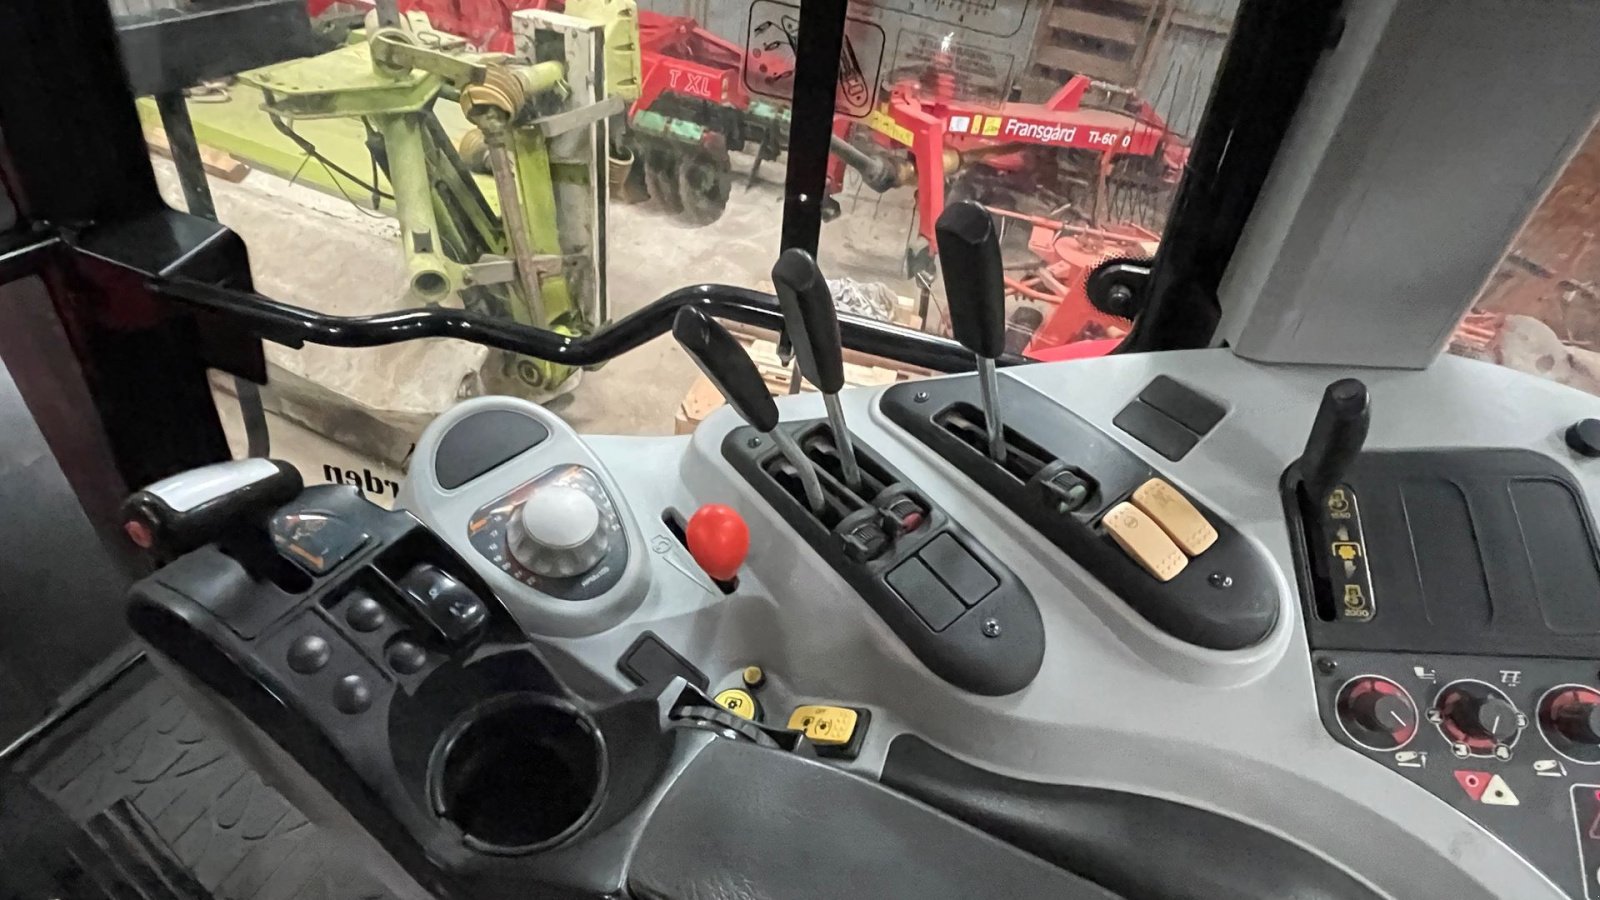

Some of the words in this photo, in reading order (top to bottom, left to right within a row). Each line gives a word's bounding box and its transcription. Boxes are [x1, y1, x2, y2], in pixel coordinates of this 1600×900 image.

[684, 72, 711, 97] XL
[1004, 118, 1077, 143] Fransgård
[1088, 130, 1131, 147] TI-600
